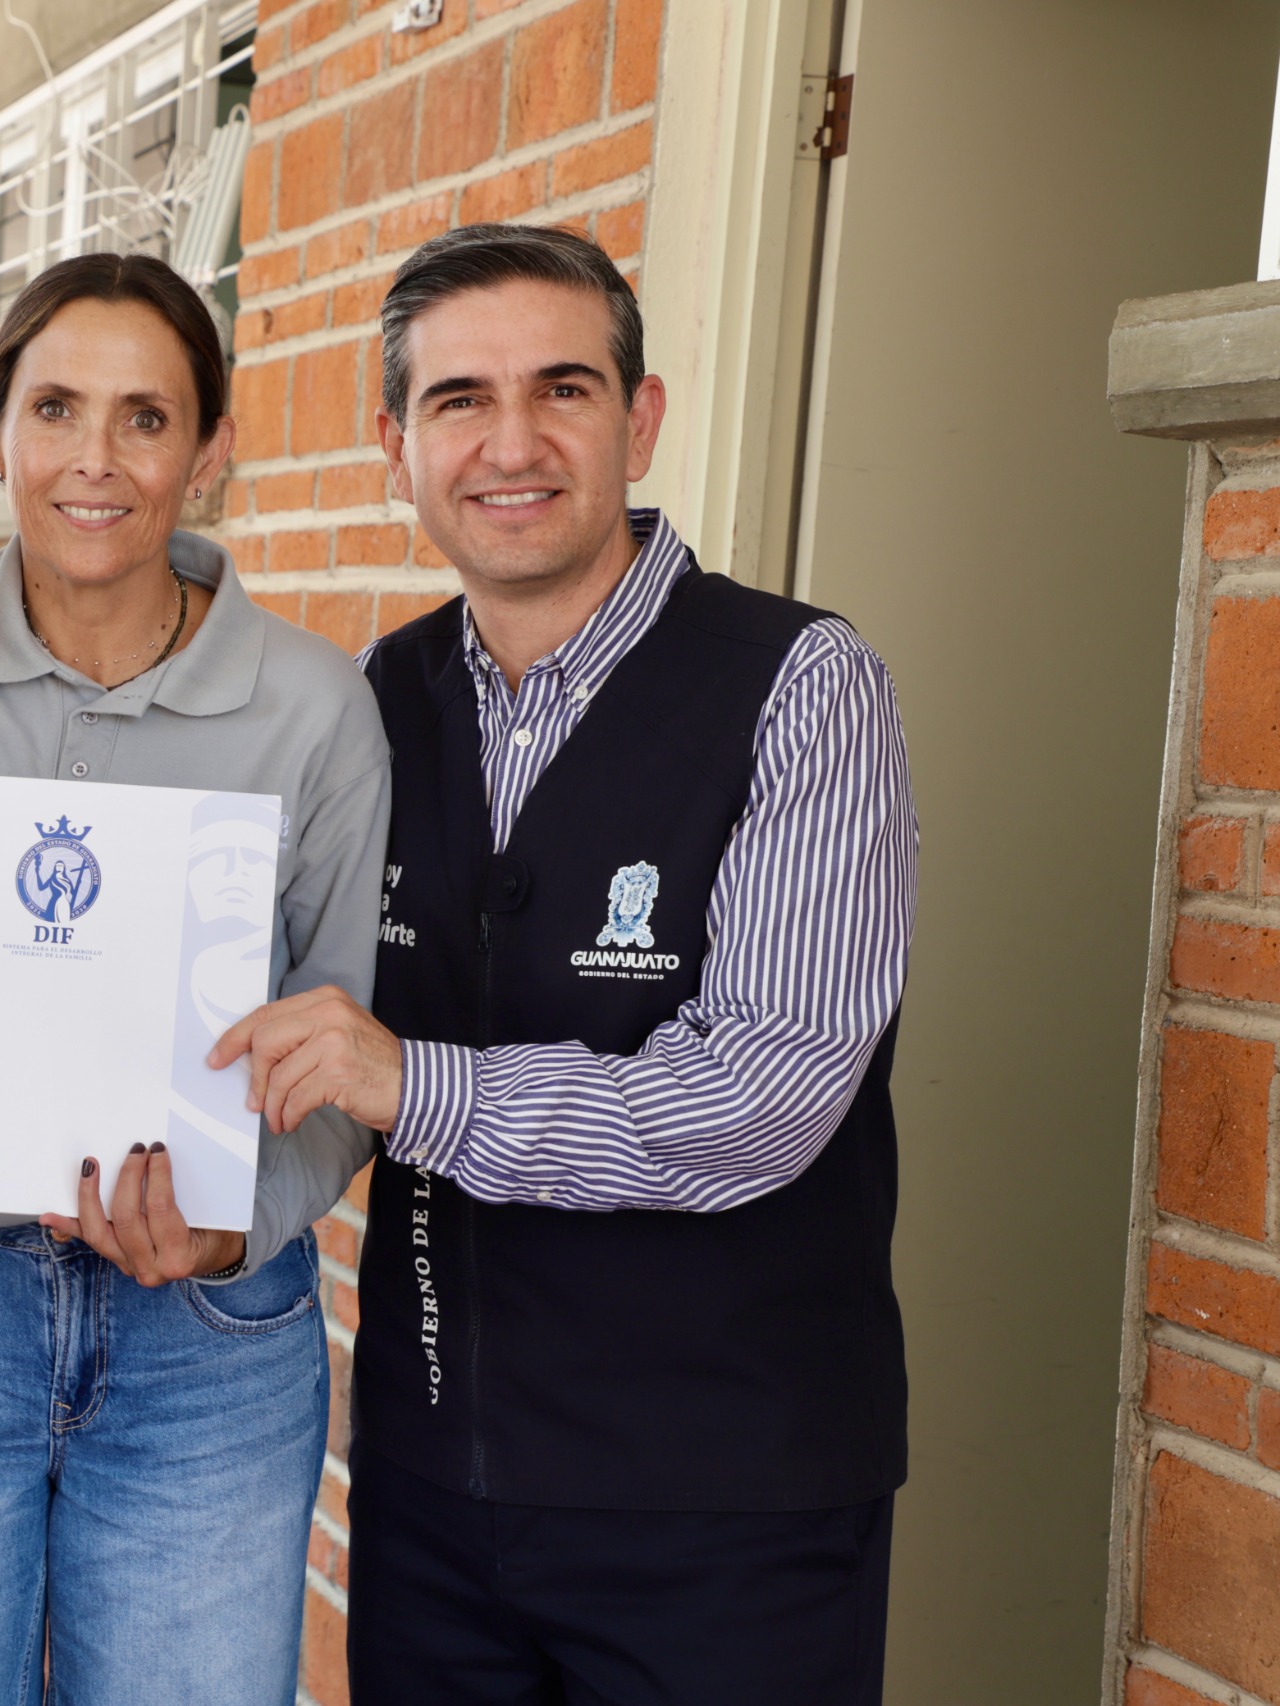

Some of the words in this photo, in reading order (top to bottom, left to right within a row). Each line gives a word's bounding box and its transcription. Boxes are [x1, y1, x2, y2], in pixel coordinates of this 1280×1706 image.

[33, 925, 74, 944] DIF
[570, 950, 680, 970] GUANAJUATO
[578, 970, 615, 978] GOBIERNO
[414, 1166, 431, 1200] LA
[412, 1209, 429, 1248] DE
[414, 1256, 442, 1405] GOBIERNO
